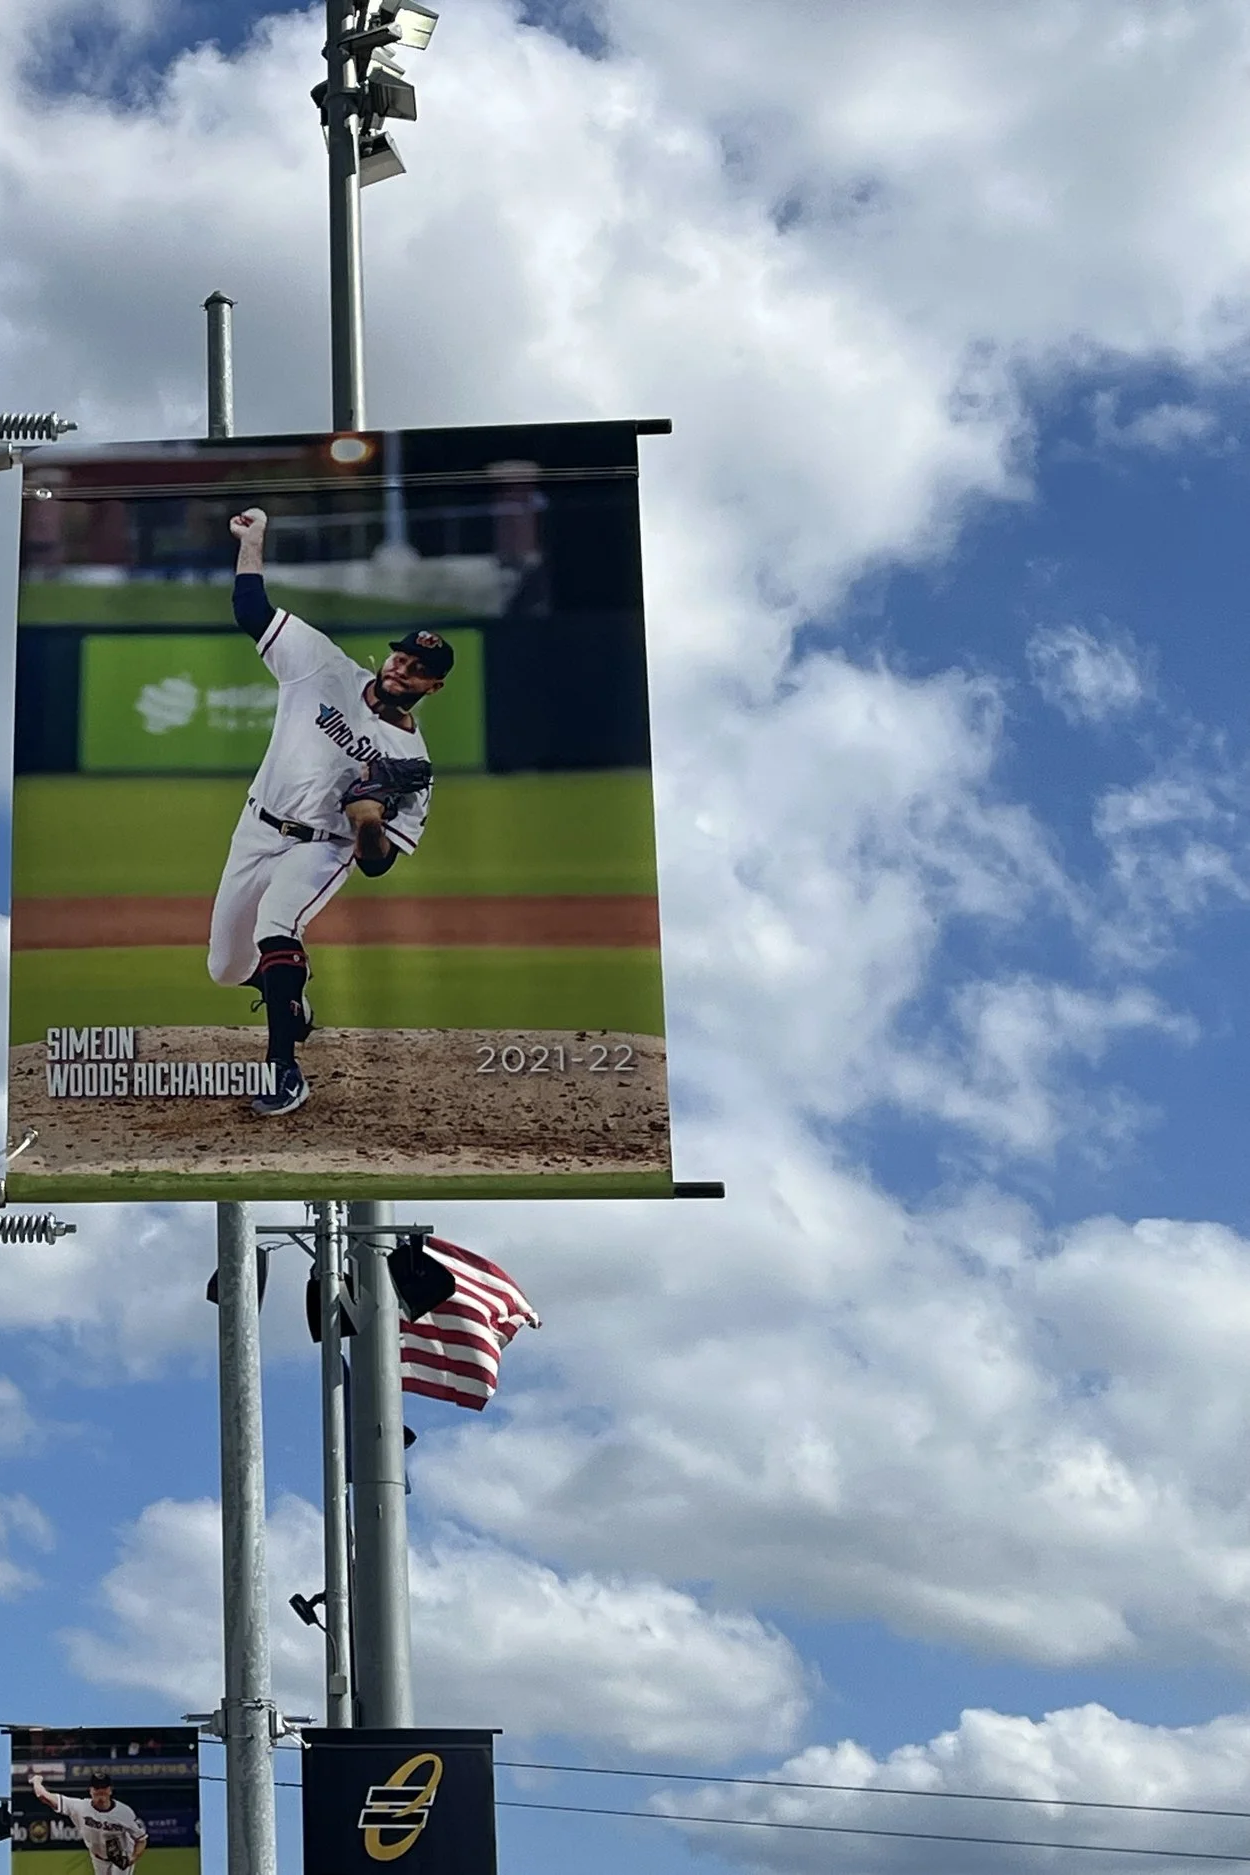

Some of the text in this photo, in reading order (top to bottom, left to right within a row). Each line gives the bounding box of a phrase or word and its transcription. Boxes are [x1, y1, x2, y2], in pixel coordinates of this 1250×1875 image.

[46, 1026, 135, 1061] SIMEON
[475, 1043, 636, 1074] 2021-22
[45, 1061, 278, 1098] WOODS RICHARDSON
